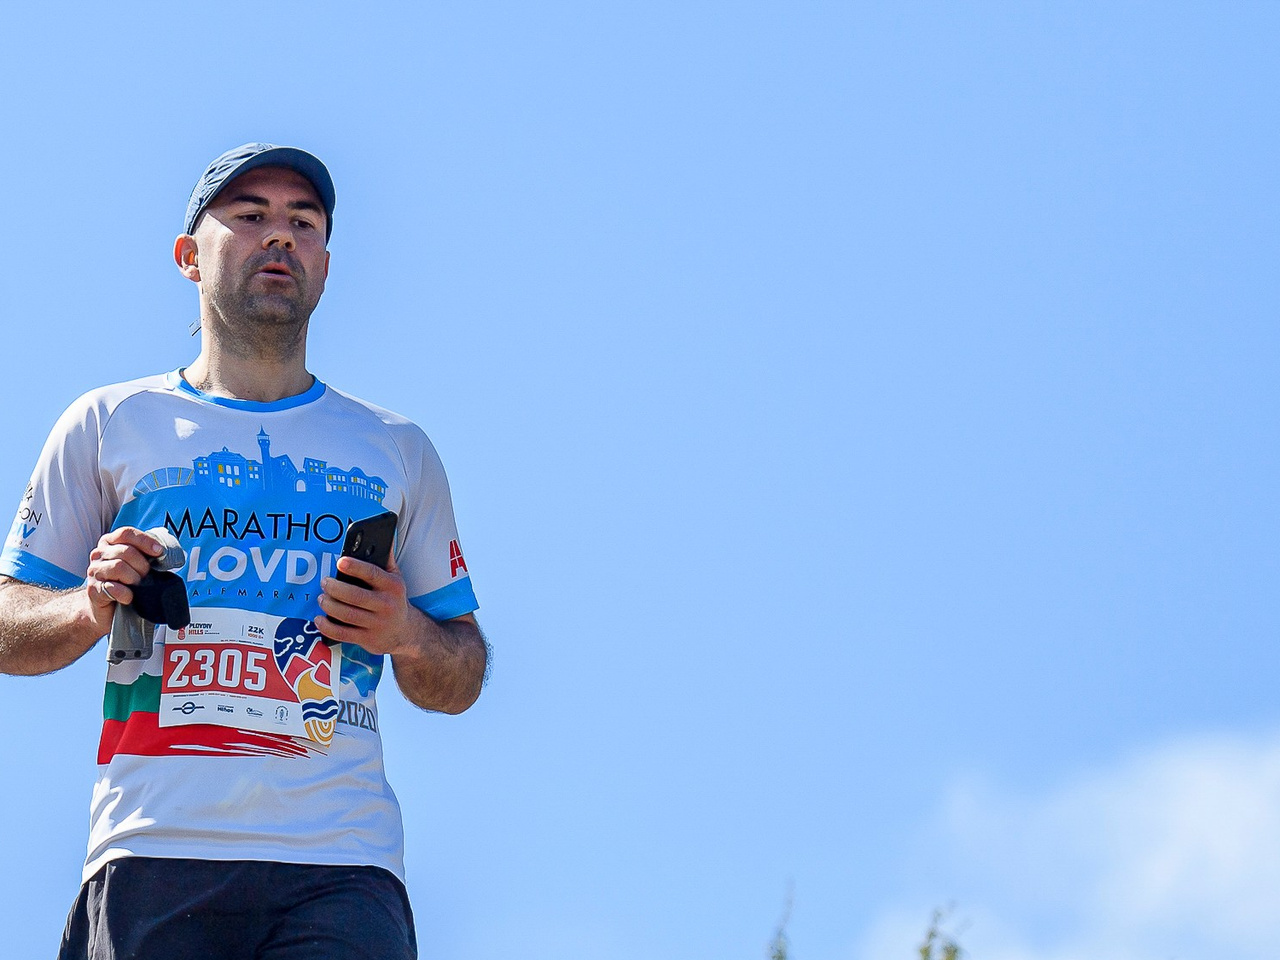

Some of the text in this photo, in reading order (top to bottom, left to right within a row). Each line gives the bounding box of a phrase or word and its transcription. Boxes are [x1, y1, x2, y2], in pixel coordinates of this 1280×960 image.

[164, 506, 354, 545] MARATHO
[184, 546, 342, 586] LOVDI
[192, 587, 312, 602] ALF MARAT
[248, 625, 265, 635] 22K
[167, 648, 268, 692] 2305
[337, 699, 377, 733] 2020
